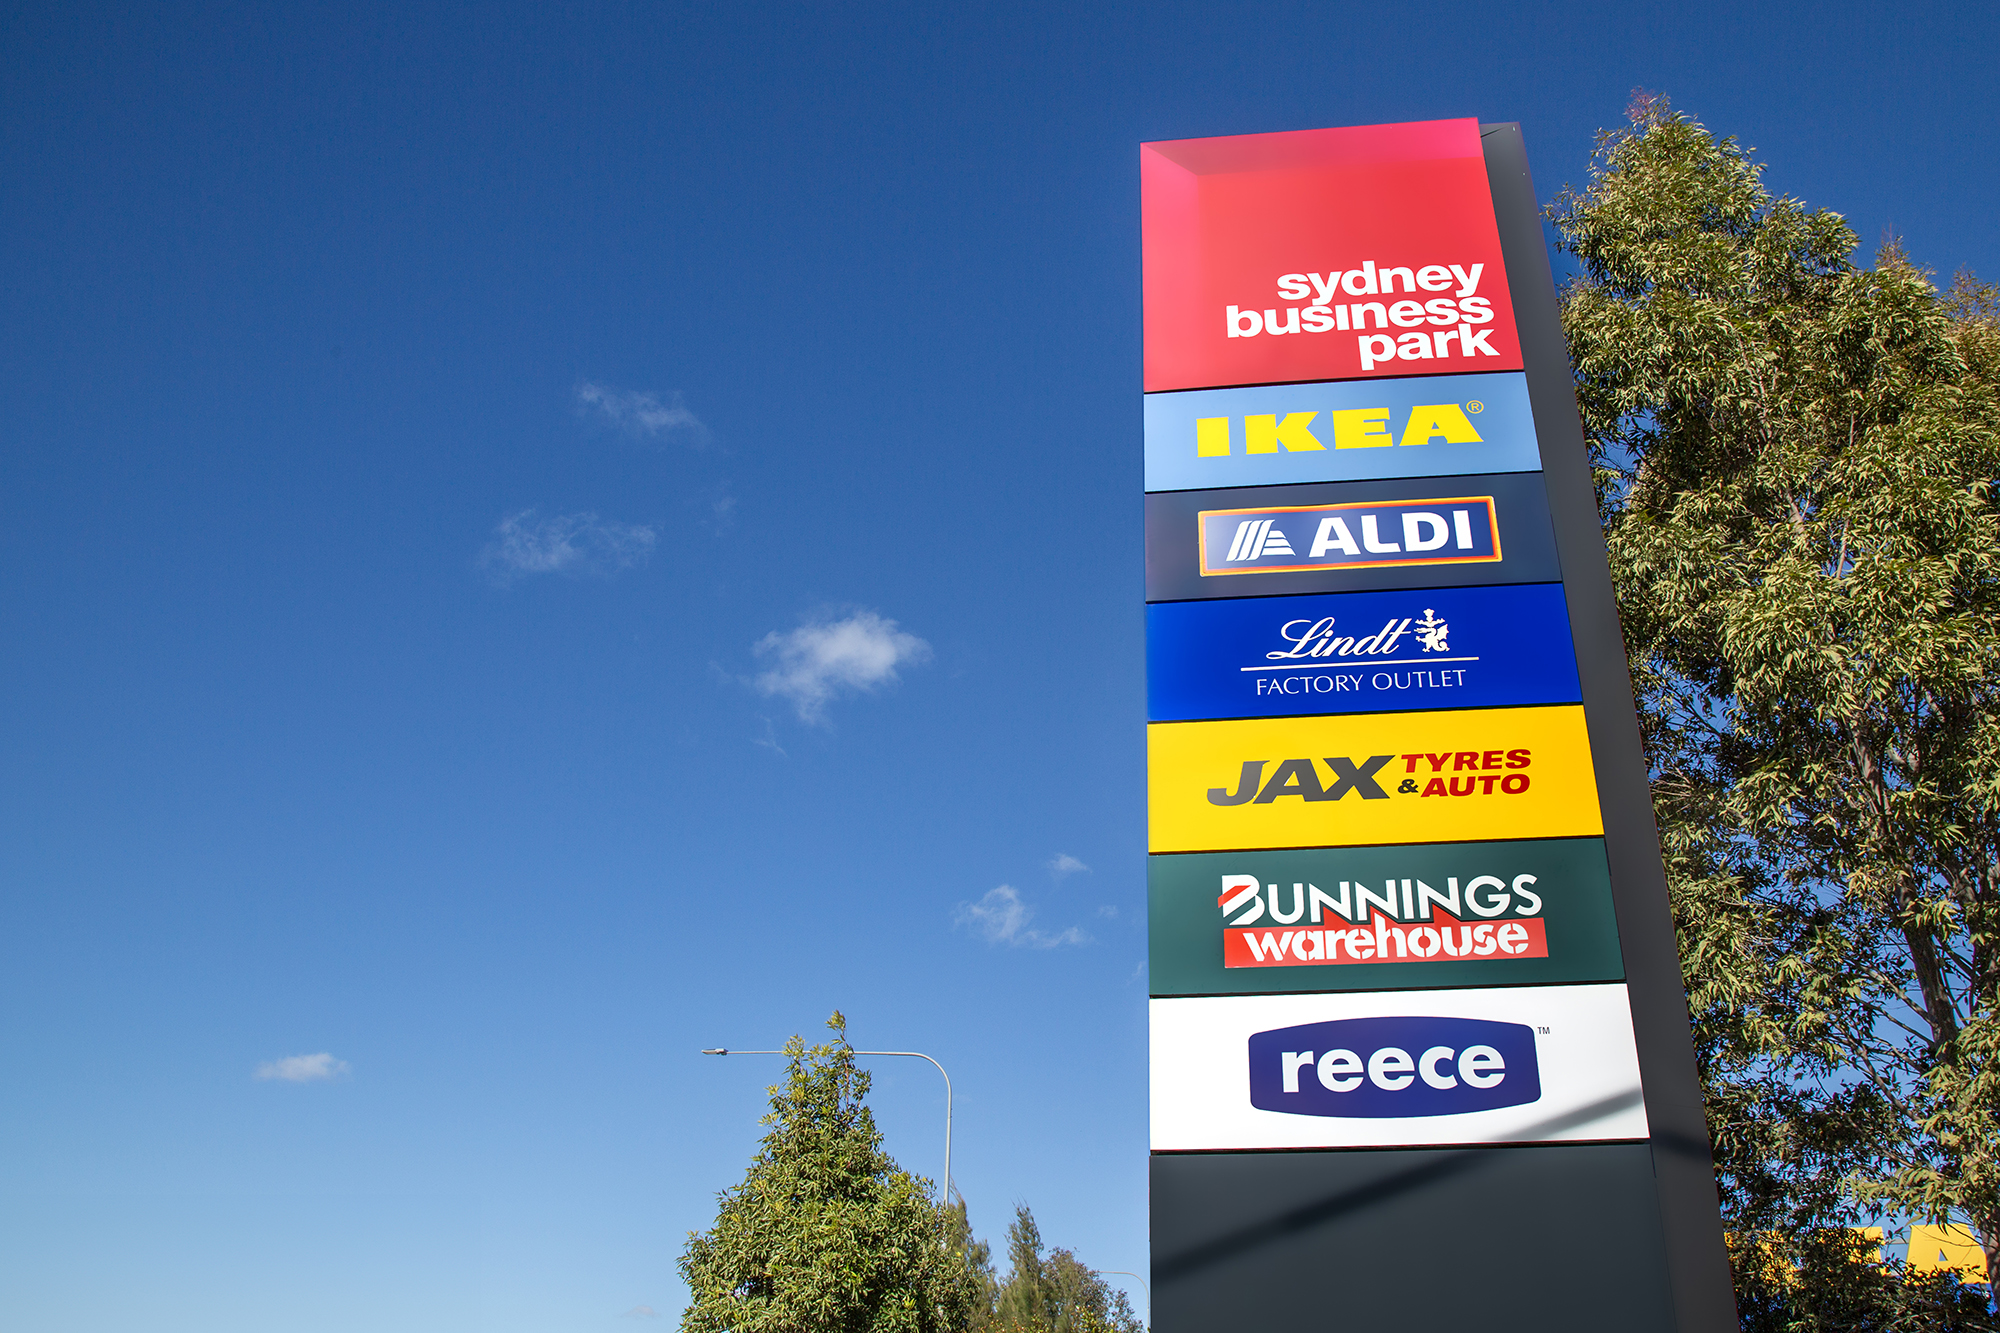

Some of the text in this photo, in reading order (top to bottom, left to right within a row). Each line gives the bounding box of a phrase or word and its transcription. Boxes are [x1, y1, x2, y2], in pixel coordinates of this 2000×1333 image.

[1277, 260, 1485, 306] sydney
[1226, 296, 1495, 338] business
[1358, 323, 1501, 371] park
[1308, 509, 1474, 558] ALDI
[1265, 616, 1412, 660] Lindt
[1255, 669, 1467, 696] FACTORY OUTLET
[1206, 754, 1397, 807] JAX
[1400, 749, 1532, 774] TYRES
[1217, 873, 1543, 926] BUNNINGS
[1242, 913, 1530, 962] warehouse
[1281, 1044, 1507, 1093] reece
